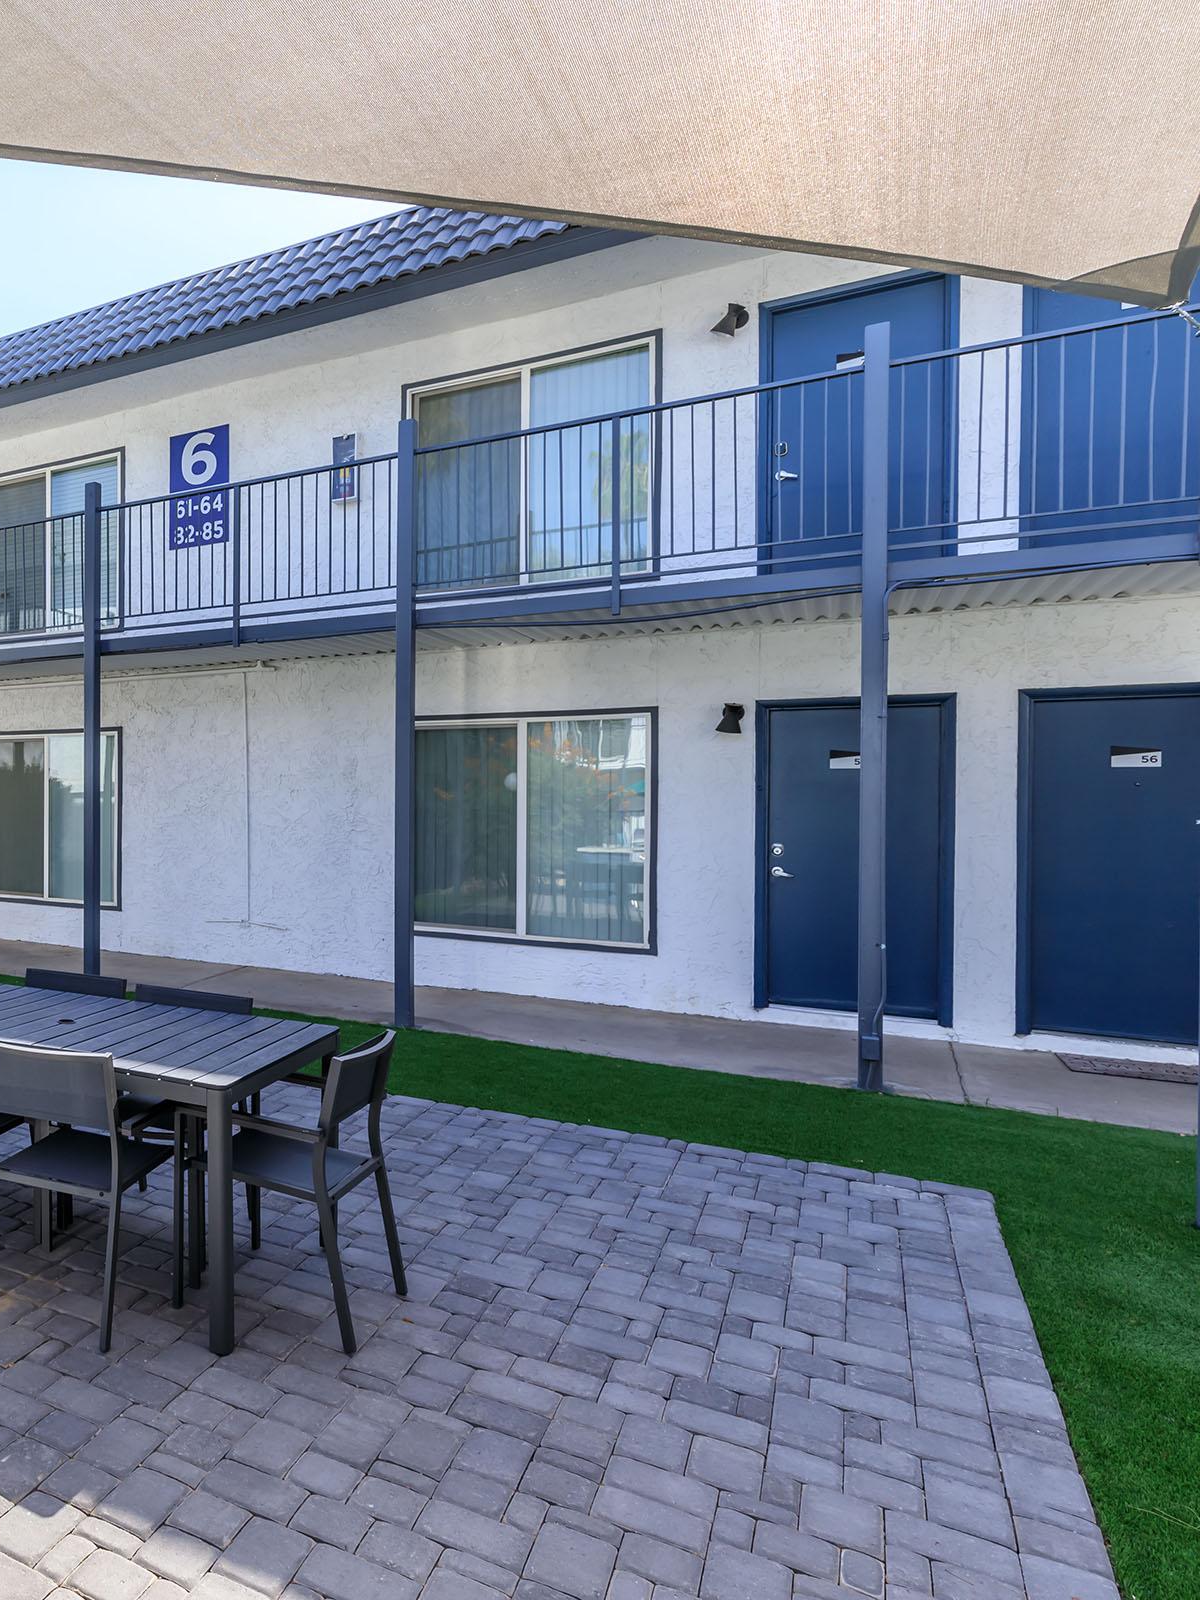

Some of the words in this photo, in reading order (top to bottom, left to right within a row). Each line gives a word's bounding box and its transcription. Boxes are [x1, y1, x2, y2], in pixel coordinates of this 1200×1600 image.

[181, 432, 217, 485] 6
[177, 494, 223, 518] 61-64
[1141, 755, 1158, 763] 56
